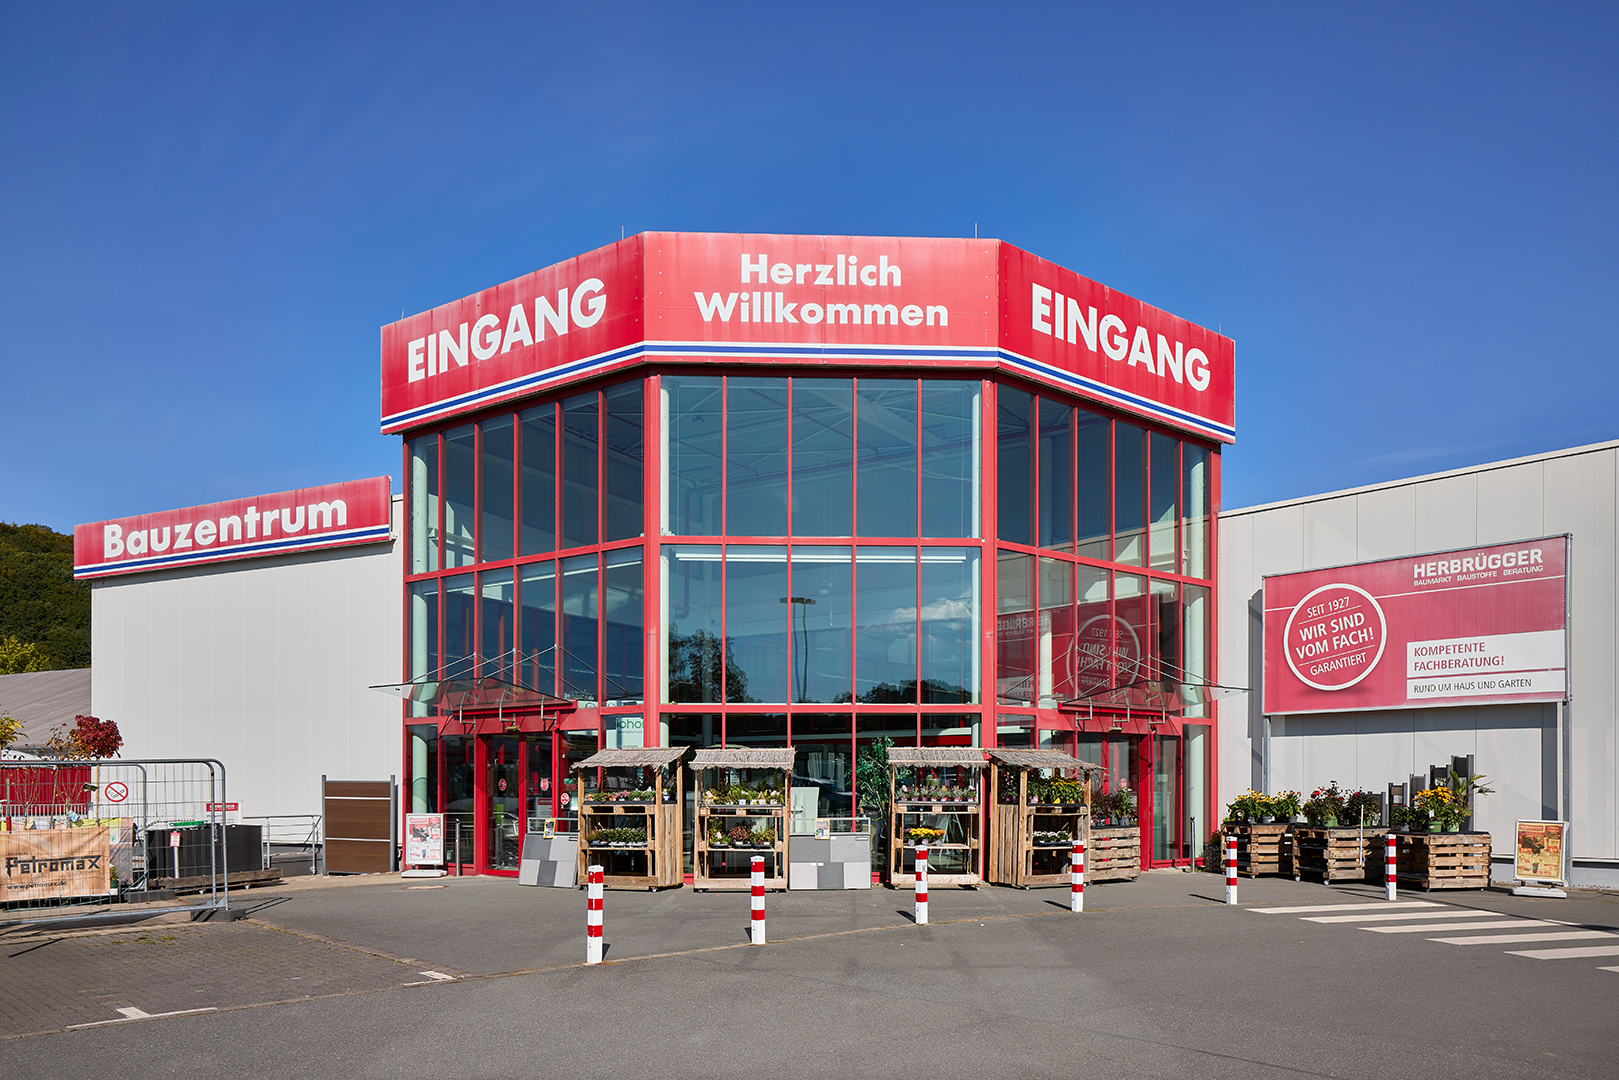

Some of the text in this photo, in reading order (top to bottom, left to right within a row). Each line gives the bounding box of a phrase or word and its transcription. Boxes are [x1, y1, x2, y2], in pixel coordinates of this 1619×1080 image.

[741, 253, 902, 287] Herzlich
[693, 291, 949, 327] Willkommen
[407, 277, 607, 383] EINGANG
[1031, 282, 1211, 392] EINGANG
[103, 499, 347, 559] Bauzentrum
[1413, 548, 1543, 579] HERBRÜGGER
[1413, 565, 1544, 586] BAUMARKT BAUSTOFFE BERATUNG
[1306, 596, 1351, 619] SEIT 1927
[1298, 611, 1366, 643] WIR SIND
[1295, 626, 1375, 660] VOM FACH!
[1413, 641, 1486, 658] KOMPETENTE
[1309, 652, 1368, 677] GARANTIERT
[1413, 655, 1505, 672] FACHBERATUNG!
[1413, 678, 1532, 694] RUND UM HAUS UND GARTEN
